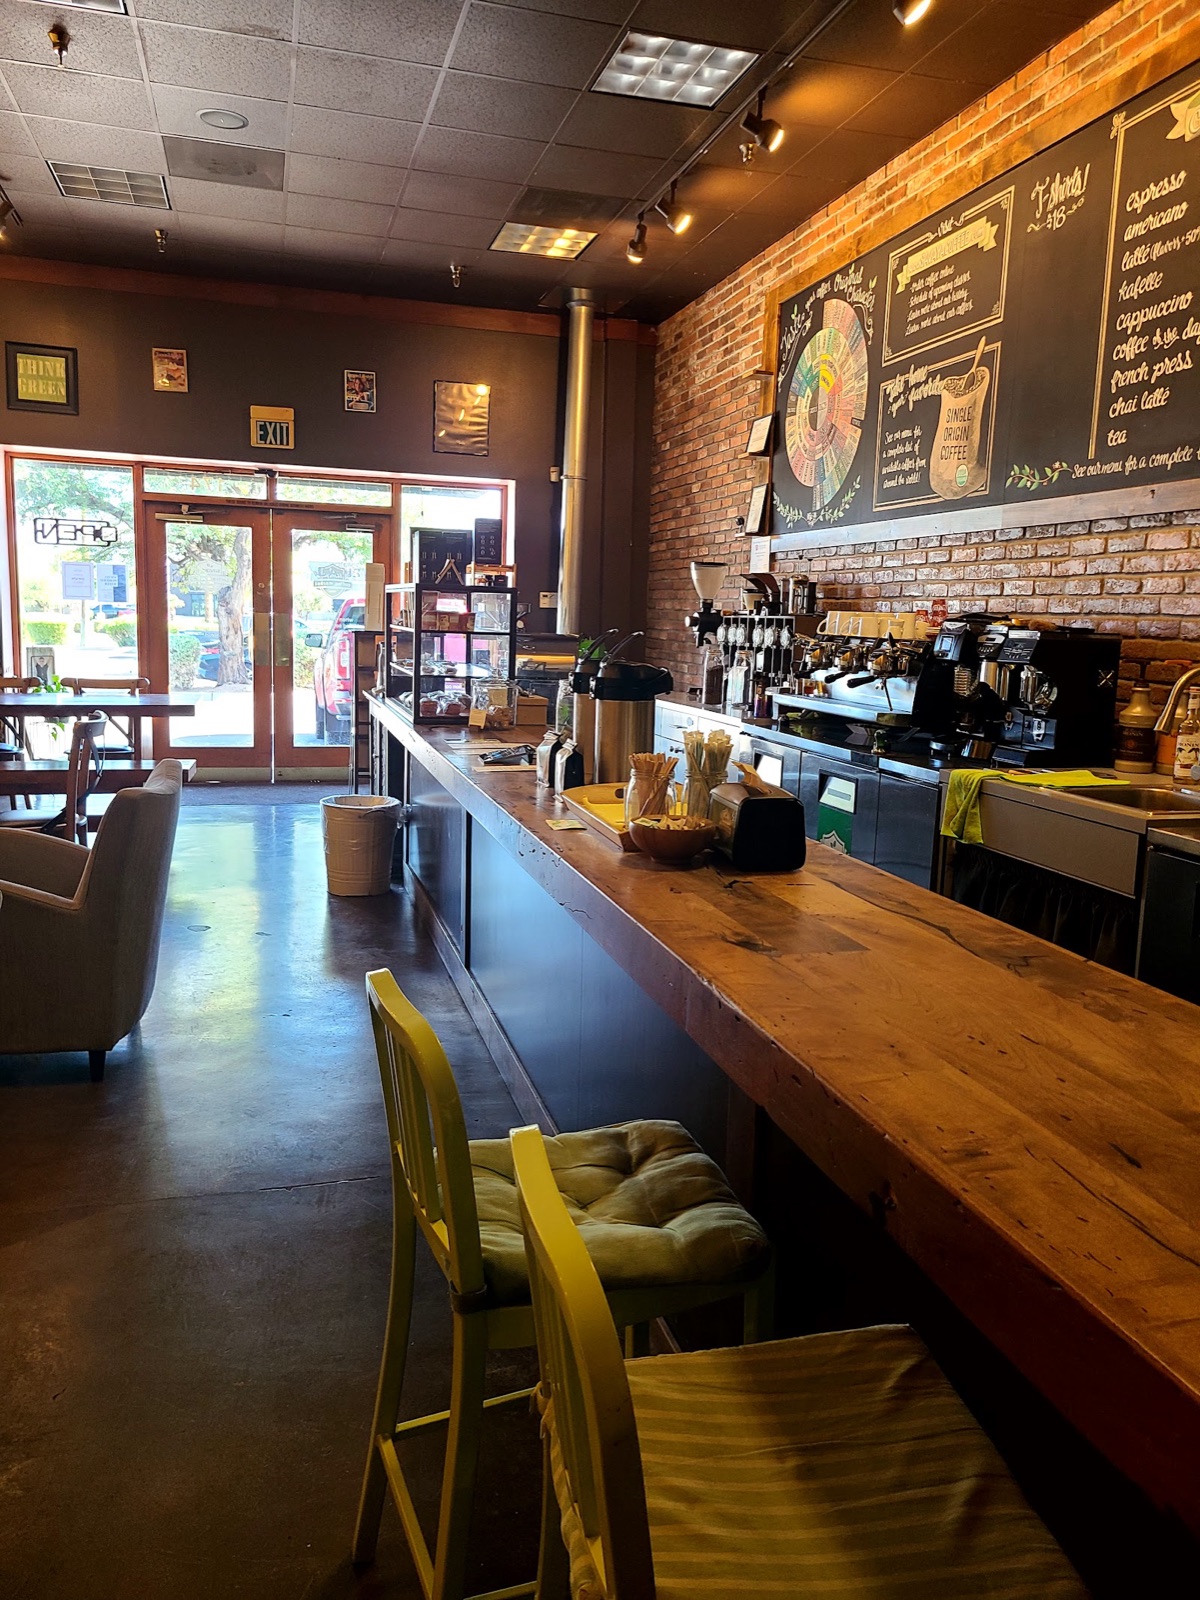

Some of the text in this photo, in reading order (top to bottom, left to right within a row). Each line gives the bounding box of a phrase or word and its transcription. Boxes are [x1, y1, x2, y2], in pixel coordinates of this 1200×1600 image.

[1031, 163, 1090, 219] T-shirts!
[1126, 170, 1187, 214] espresso
[1046, 205, 1066, 231] $18
[1124, 201, 1189, 242] americano
[1116, 291, 1193, 334] cappuccino
[1113, 335, 1149, 361] coffee
[1152, 328, 1163, 350] of
[1164, 327, 1179, 349] the
[18, 358, 65, 378] THINK
[1111, 350, 1193, 393] french press
[18, 377, 66, 396] GREEN
[946, 406, 972, 423] SINGLE
[1109, 395, 1138, 418] chai
[257, 421, 289, 445] EXIT
[885, 431, 893, 445] See
[943, 426, 970, 441] ORIGIN
[1107, 429, 1127, 447] tea
[940, 445, 968, 460] COFFEE
[1072, 464, 1087, 479] See
[1086, 461, 1102, 476] our
[1101, 460, 1123, 474] menu
[1125, 455, 1138, 476] for
[1139, 456, 1147, 468] a
[1149, 445, 1194, 471] complete
